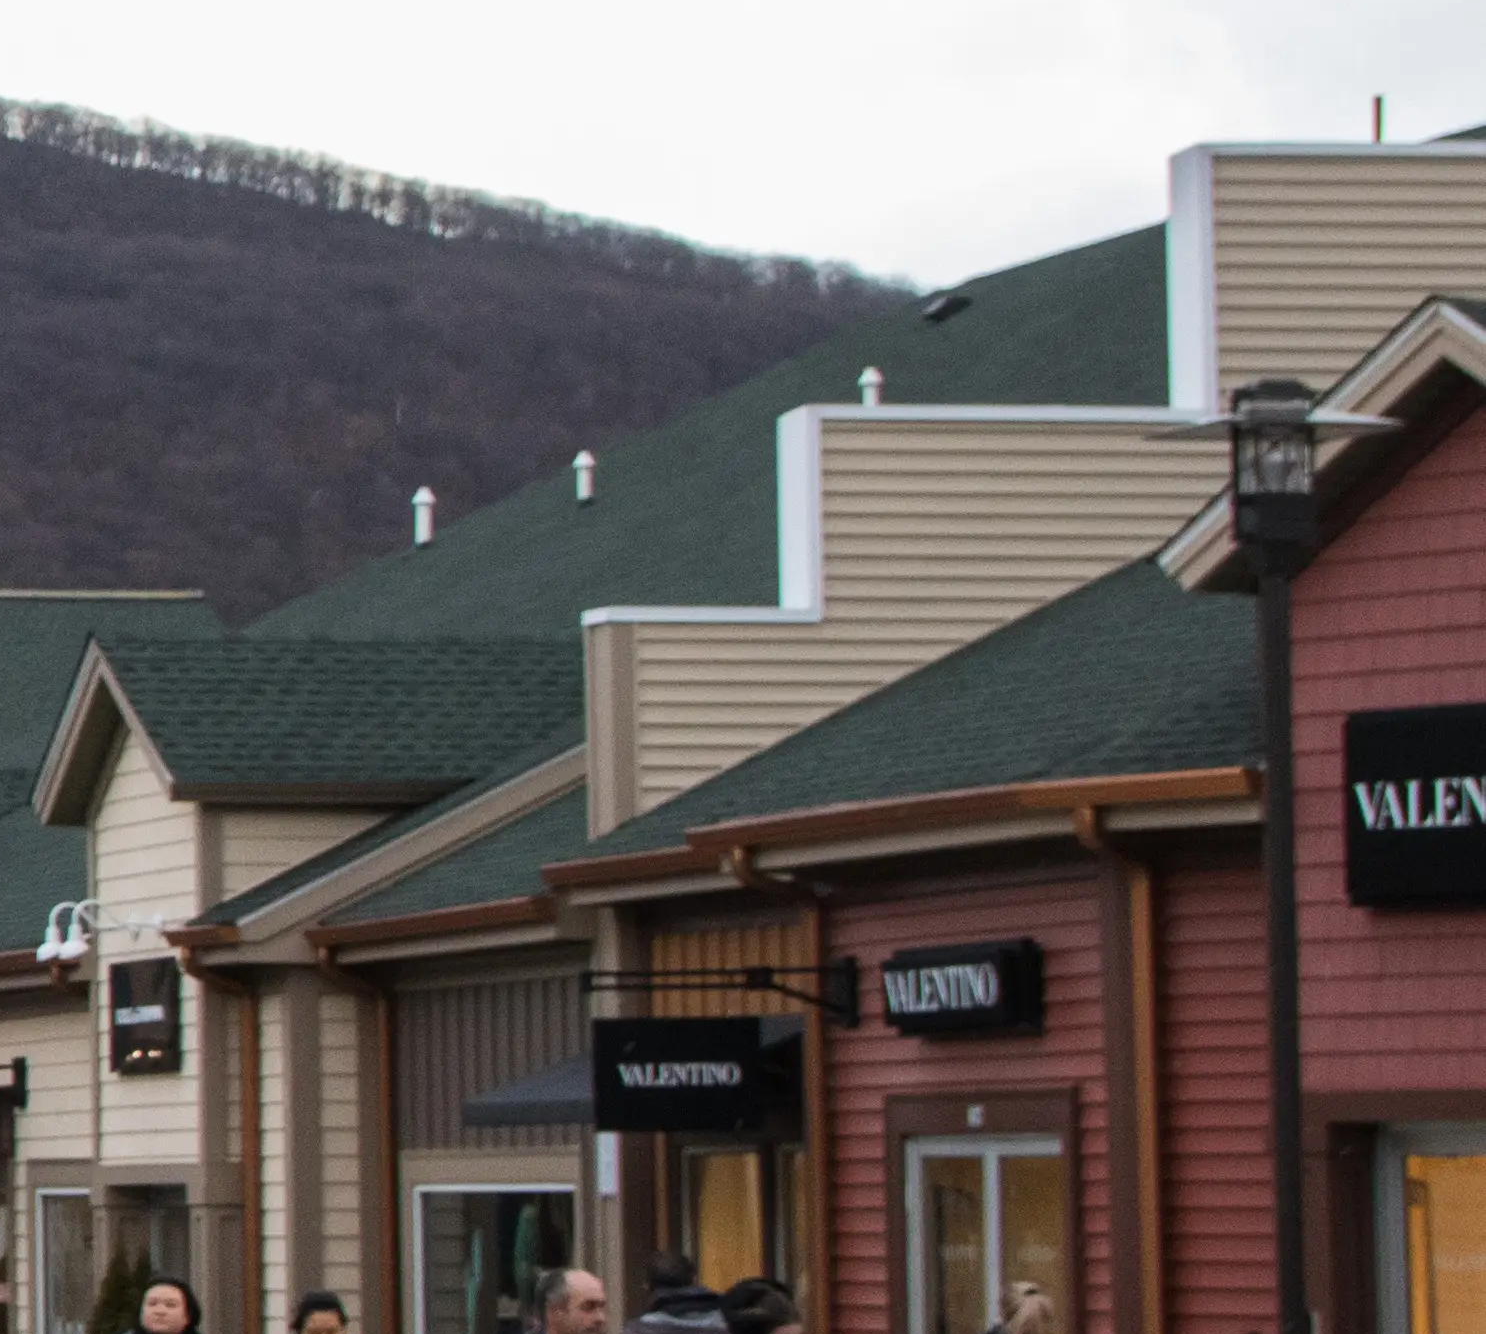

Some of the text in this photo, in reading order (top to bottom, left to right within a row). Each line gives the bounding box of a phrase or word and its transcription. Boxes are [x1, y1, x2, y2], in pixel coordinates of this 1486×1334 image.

[1352, 775, 1486, 831] VALEN
[884, 963, 1000, 1015] VALENTINO
[617, 1061, 742, 1088] VALENTINO
